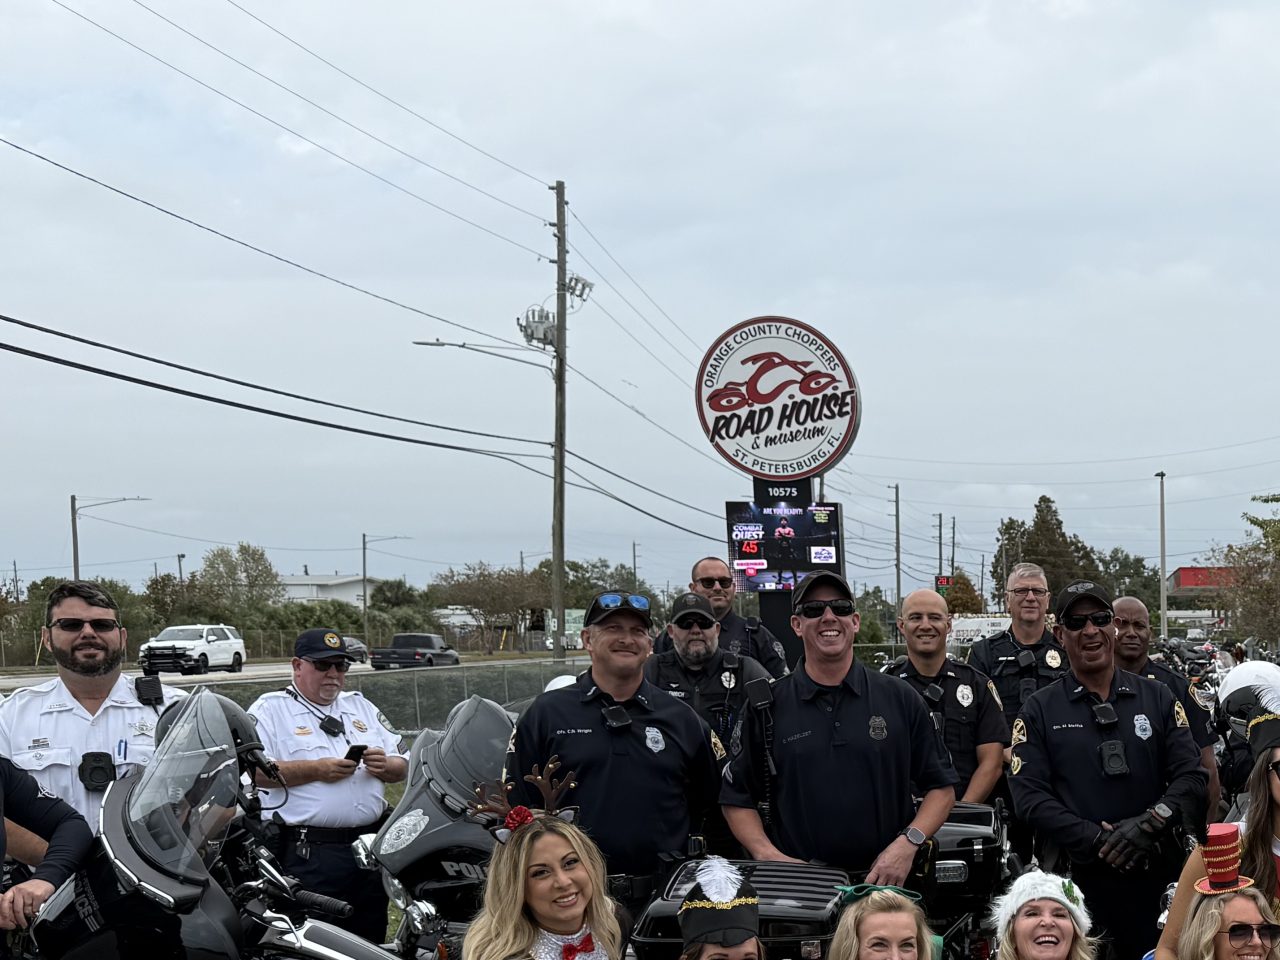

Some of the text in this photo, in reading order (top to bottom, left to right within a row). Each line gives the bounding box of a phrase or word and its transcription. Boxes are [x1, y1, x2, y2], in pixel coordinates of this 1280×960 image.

[705, 324, 840, 388] ORANGE COUNTY CHOPPERS
[709, 390, 855, 443] ROAD HOUSE
[751, 425, 828, 450] & museum
[732, 432, 843, 473] ST. PETERSBURG, FL.
[768, 488, 798, 497] 10575
[732, 531, 765, 540] QUEST
[742, 541, 758, 553] 45
